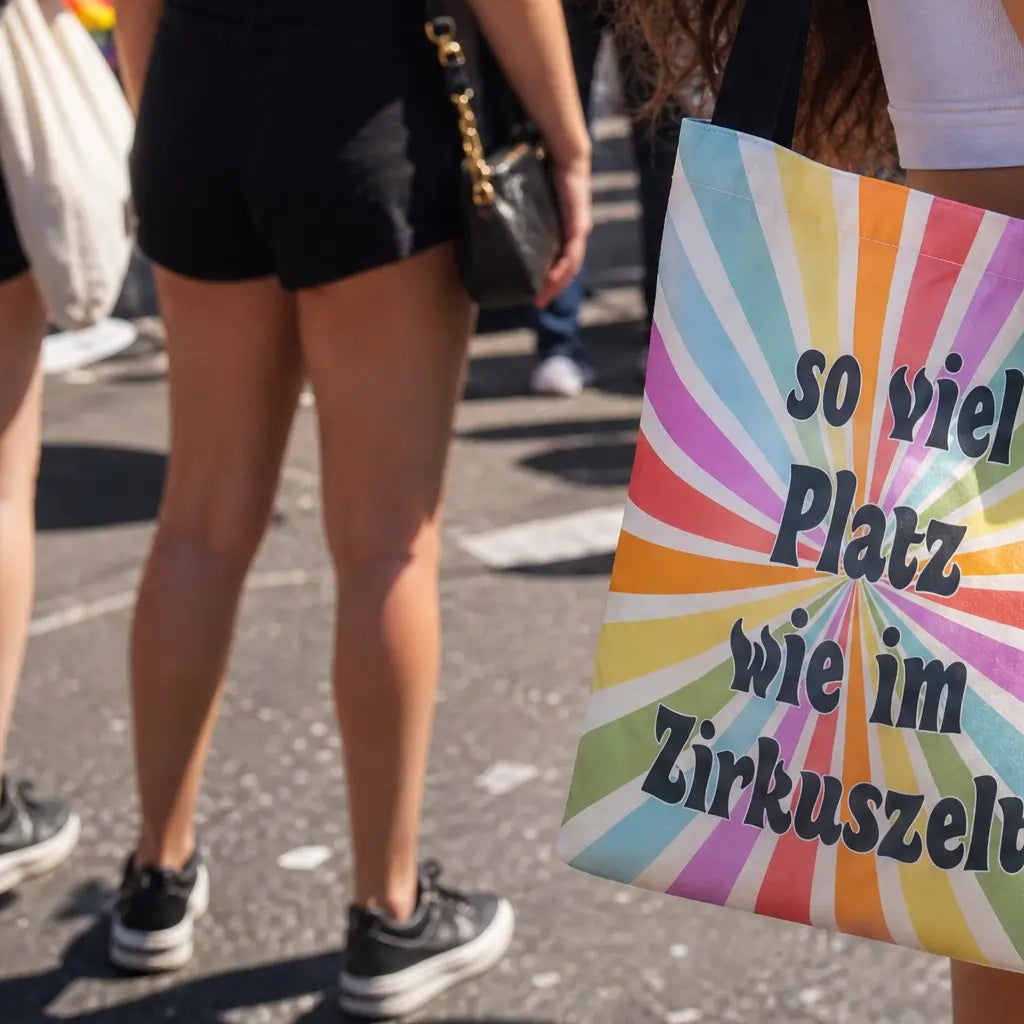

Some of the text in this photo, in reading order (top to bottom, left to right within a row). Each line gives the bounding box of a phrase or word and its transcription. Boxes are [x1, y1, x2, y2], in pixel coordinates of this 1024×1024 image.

[786, 349, 1024, 465] so viel
[769, 463, 967, 597] Platz
[730, 607, 967, 735] wie im
